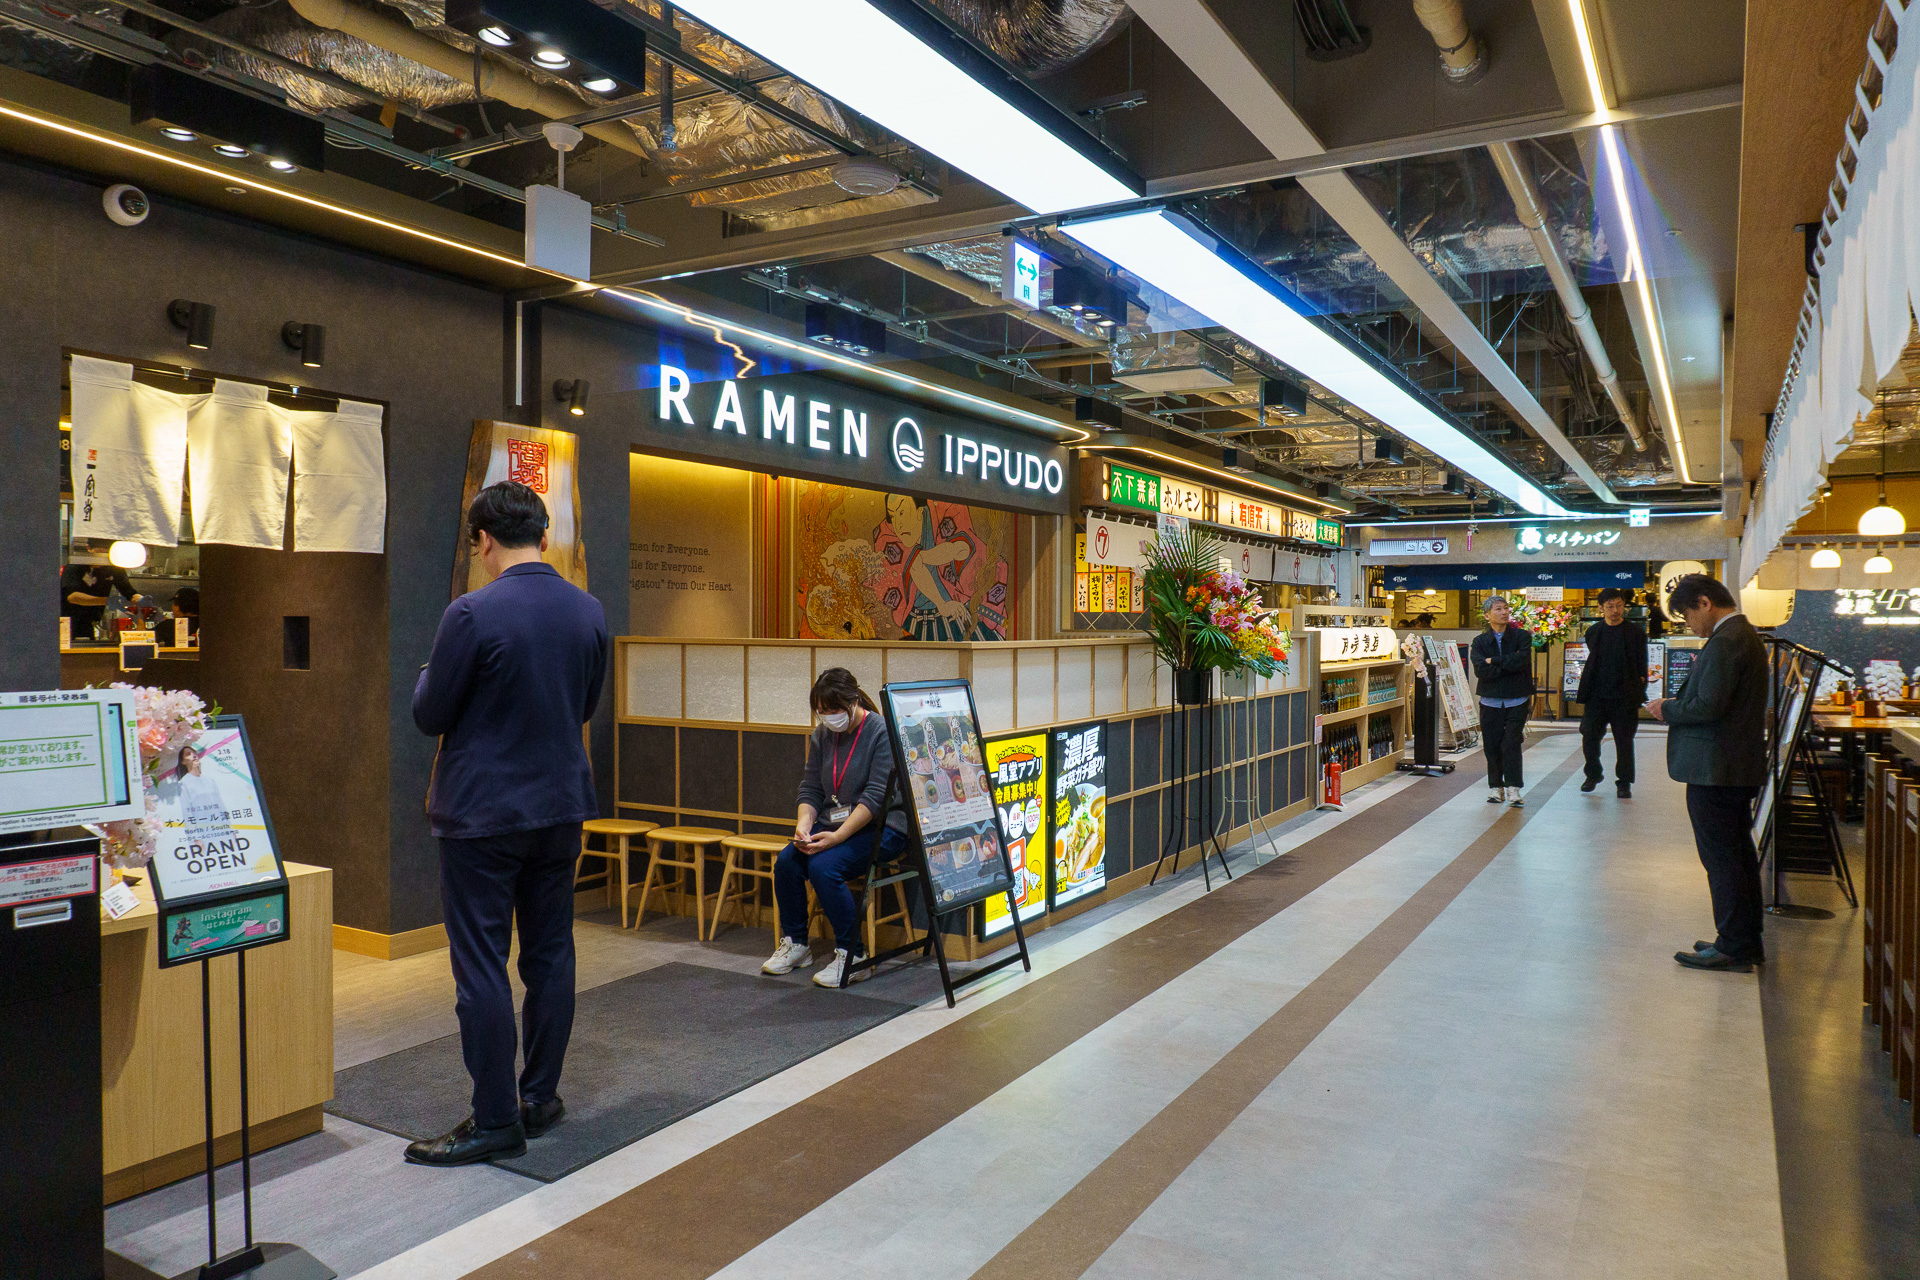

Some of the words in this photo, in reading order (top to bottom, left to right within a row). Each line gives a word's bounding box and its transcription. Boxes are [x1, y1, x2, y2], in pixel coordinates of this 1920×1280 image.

[659, 364, 868, 458] RAMEN
[944, 434, 1064, 494] IPPUDO
[1163, 484, 1202, 513] ホルモン
[1239, 502, 1263, 530] 有頂天
[1317, 523, 1339, 544] 大衆酒場
[651, 542, 665, 553] for
[667, 544, 711, 557] Everyone.
[630, 560, 643, 570] ile
[645, 560, 659, 571] for
[661, 561, 705, 574] Everyone.
[667, 579, 688, 590] from
[690, 580, 706, 591] Our
[708, 581, 734, 592] Heart.
[1063, 725, 1100, 771] 濃厚
[990, 756, 1043, 785] 一風堂アプリ
[184, 826, 205, 835] North
[210, 823, 231, 832] South
[173, 837, 251, 861] GRAND
[187, 852, 247, 875] OPEN
[200, 906, 253, 922] Instagram
